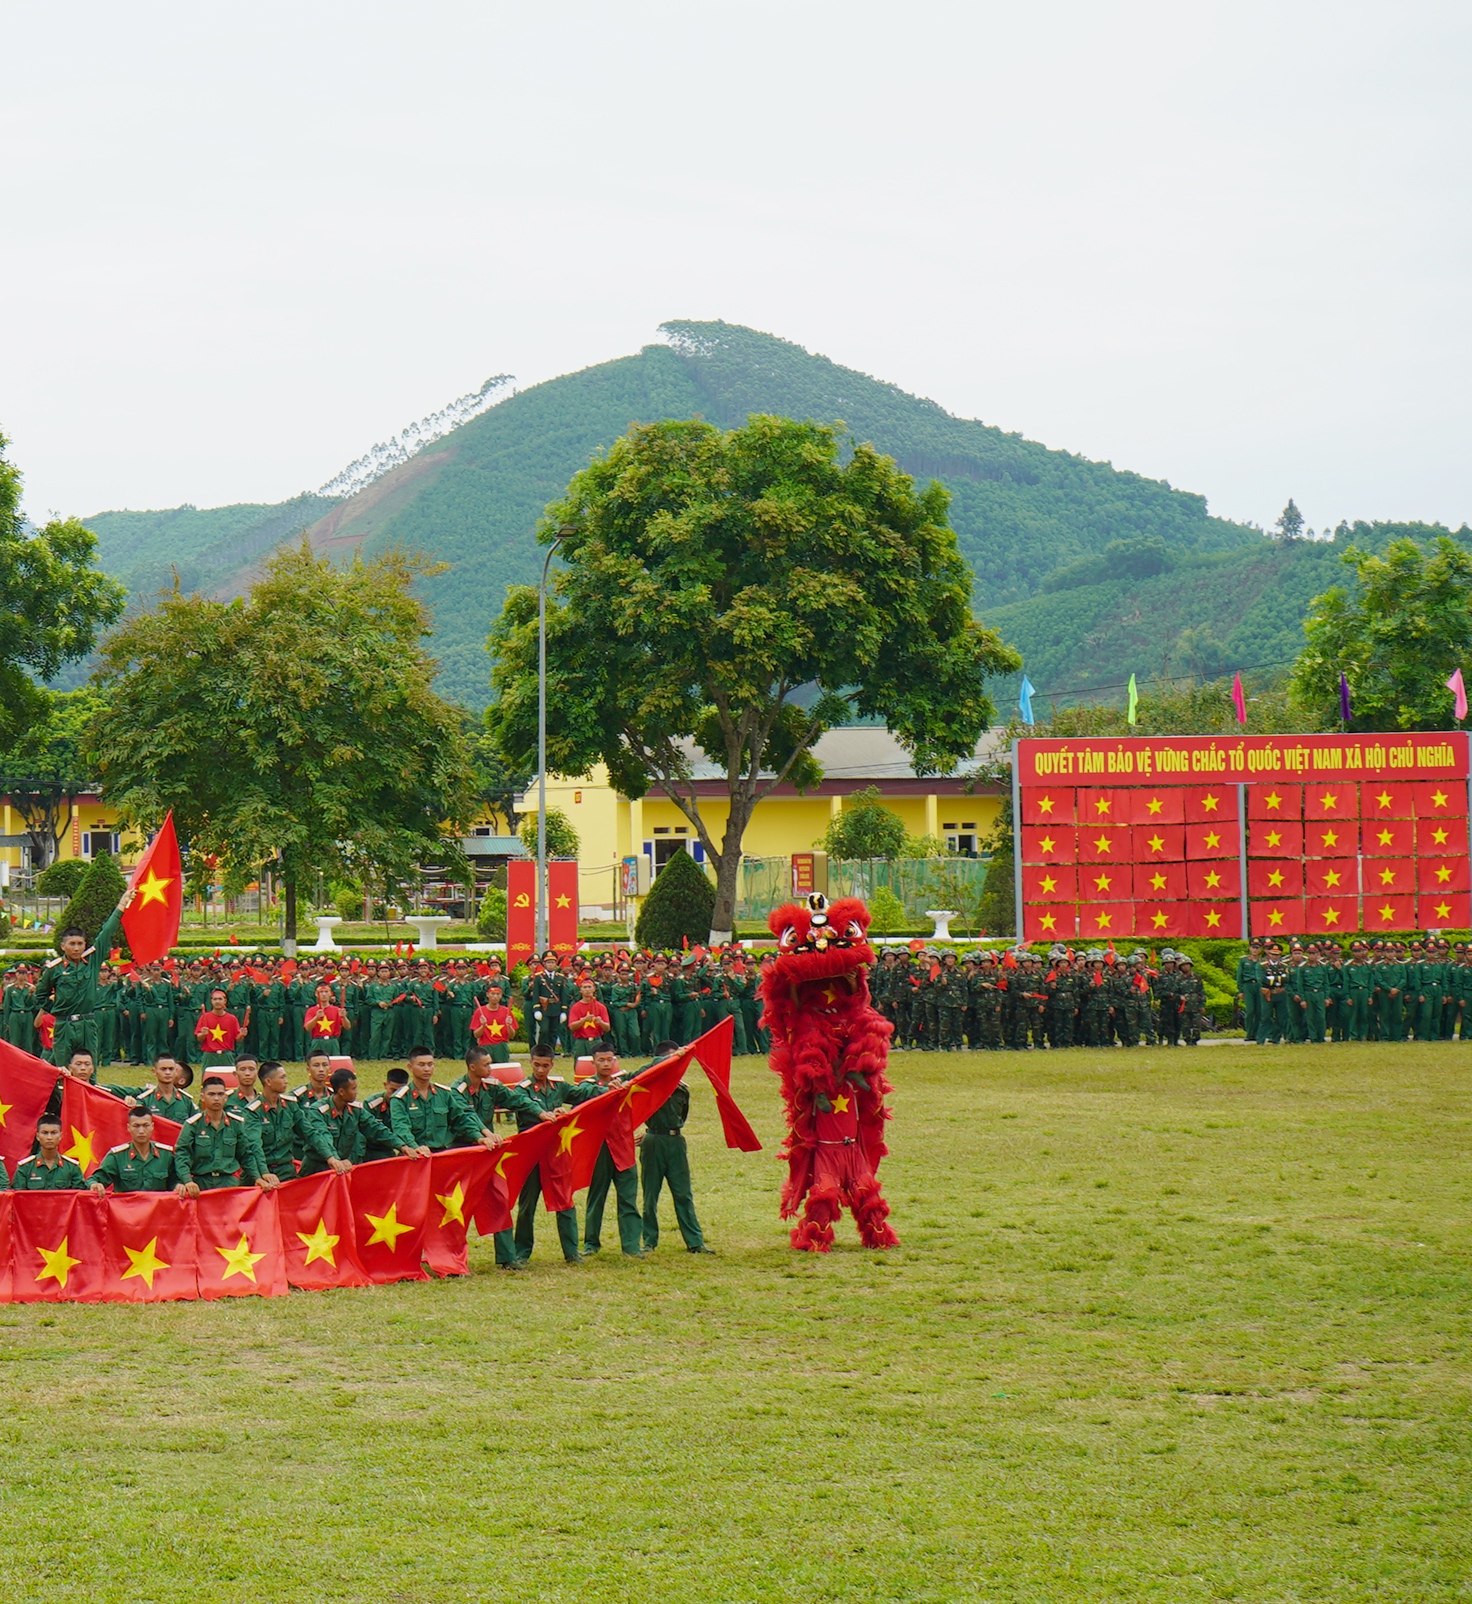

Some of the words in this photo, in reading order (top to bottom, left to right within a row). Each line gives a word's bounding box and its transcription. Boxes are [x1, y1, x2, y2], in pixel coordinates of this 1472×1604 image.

[1035, 745, 1074, 776] QUYẾT
[1077, 747, 1105, 773] TÂM
[1108, 744, 1133, 773] BẢO
[1136, 746, 1152, 777] VỆ
[1155, 746, 1189, 773] VỮNG
[1192, 742, 1226, 771] CHẮC
[1228, 741, 1244, 771] TỔ
[1247, 742, 1281, 773] QUỐC
[1284, 744, 1310, 775] VIỆT
[1313, 748, 1343, 769] NAM
[1345, 743, 1363, 769] XÃ
[1365, 742, 1386, 773] HỘI
[1389, 740, 1414, 768] CHỦ
[1417, 742, 1455, 767] NGHĨA
